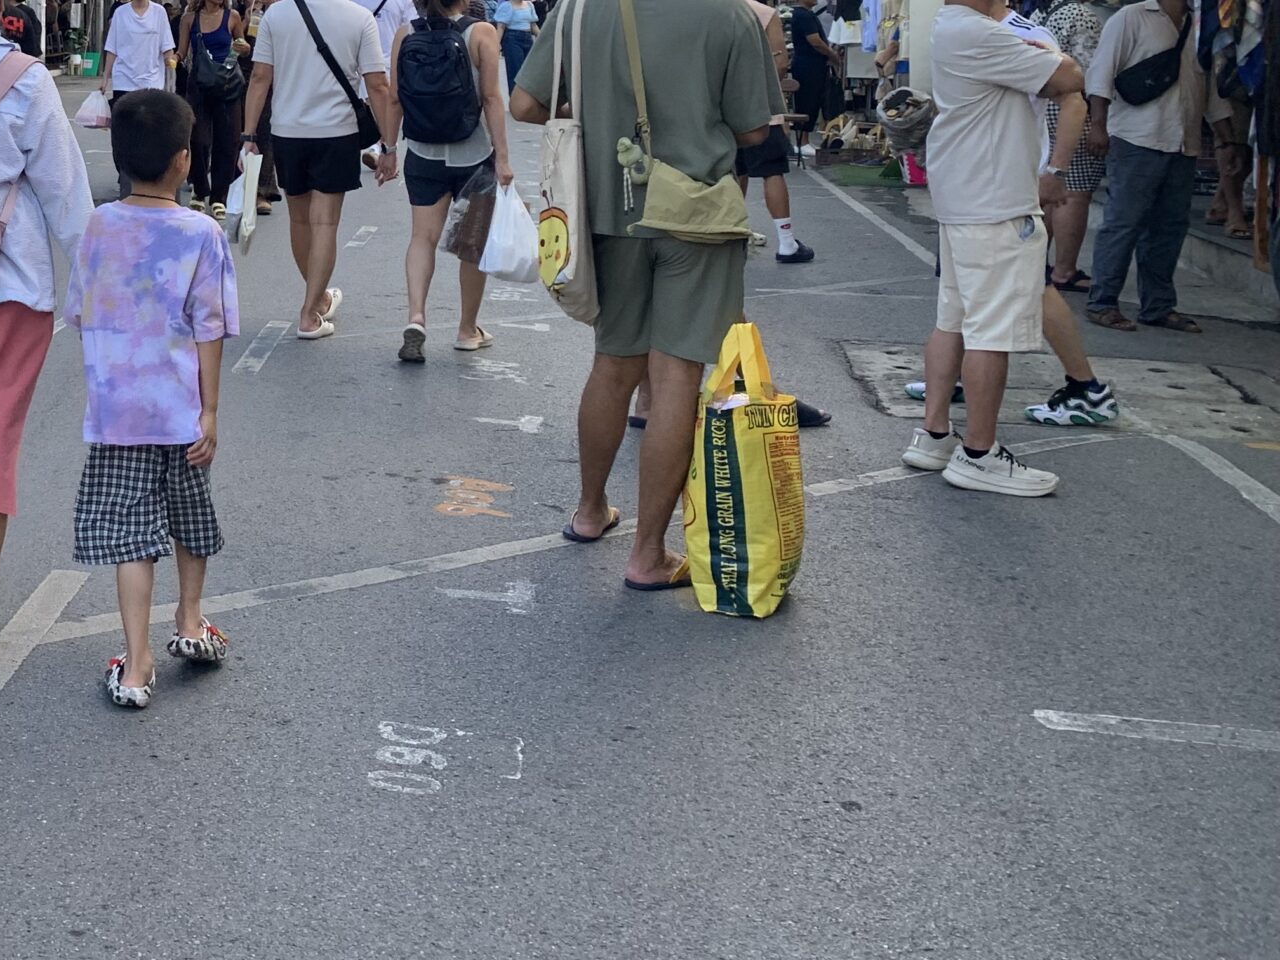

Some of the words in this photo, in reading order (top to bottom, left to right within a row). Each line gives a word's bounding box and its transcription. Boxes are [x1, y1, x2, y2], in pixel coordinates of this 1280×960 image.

[745, 403, 776, 430] TWIN
[711, 418, 727, 446] RICE
[713, 449, 732, 488] WHITE
[715, 490, 735, 527] GRAIN
[719, 530, 737, 560] LONG
[721, 561, 738, 591] THAI
